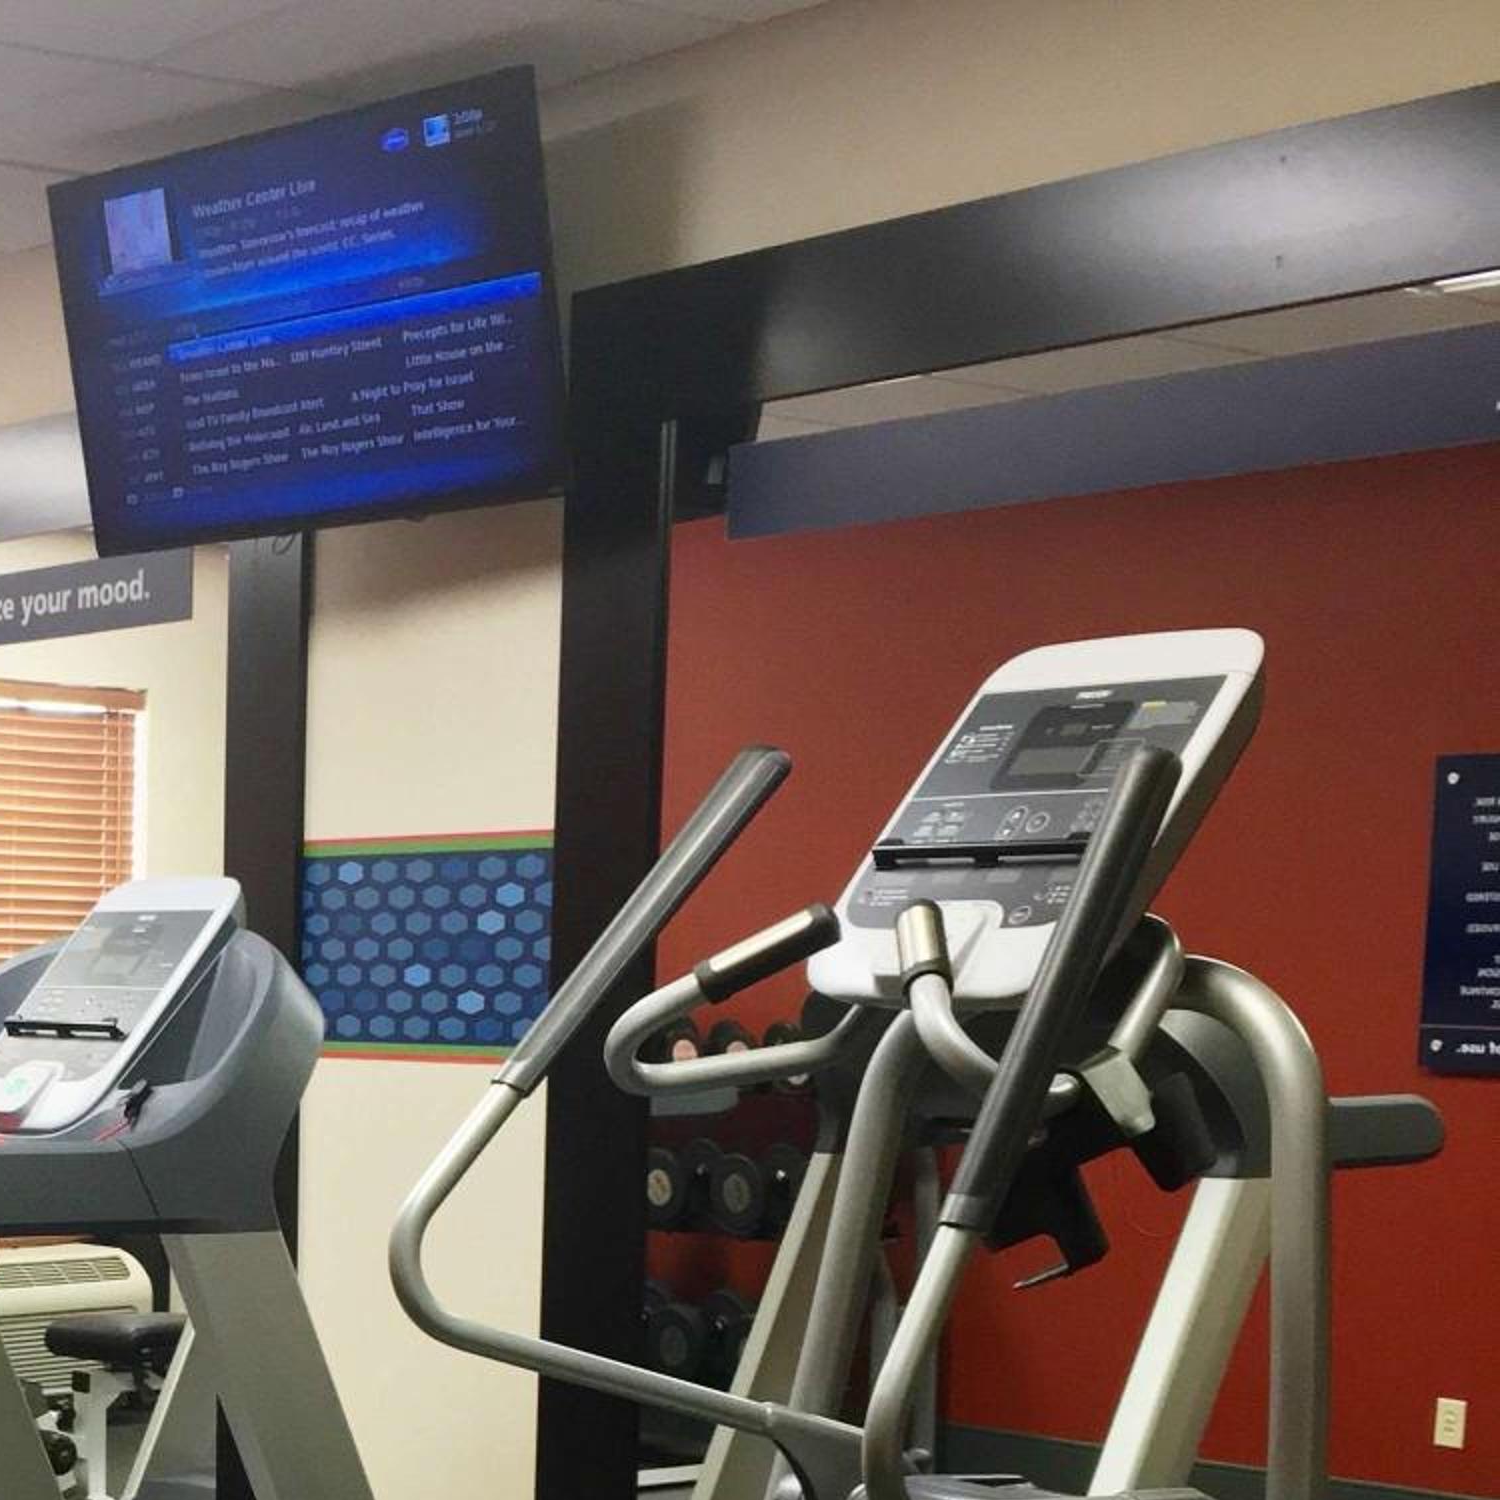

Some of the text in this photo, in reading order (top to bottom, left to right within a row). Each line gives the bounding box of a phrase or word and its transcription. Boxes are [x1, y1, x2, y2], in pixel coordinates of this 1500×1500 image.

[192, 178, 316, 217] Weather Center Live
[403, 324, 448, 342] Precepts
[450, 320, 464, 333] for
[467, 316, 487, 330] Life
[349, 337, 381, 351] Street
[405, 339, 502, 366] Little House on the
[231, 363, 240, 373] to
[243, 360, 257, 371] the
[360, 386, 388, 402] Night
[390, 383, 401, 394] to
[403, 380, 425, 395] Pray
[427, 375, 442, 388] for
[444, 371, 473, 384] Israel
[411, 398, 464, 414] That Show
[207, 415, 217, 426] TV
[220, 410, 249, 425] Family
[316, 420, 339, 431] Land
[342, 416, 359, 427] and
[414, 423, 473, 441] Intelligence
[475, 419, 491, 431] for
[301, 433, 404, 458] The Roy Rogers Show
[193, 463, 208, 474] The
[211, 460, 227, 474] Roy
[263, 451, 288, 462] Show
[20, 587, 70, 627] your
[77, 569, 150, 609] mood.
